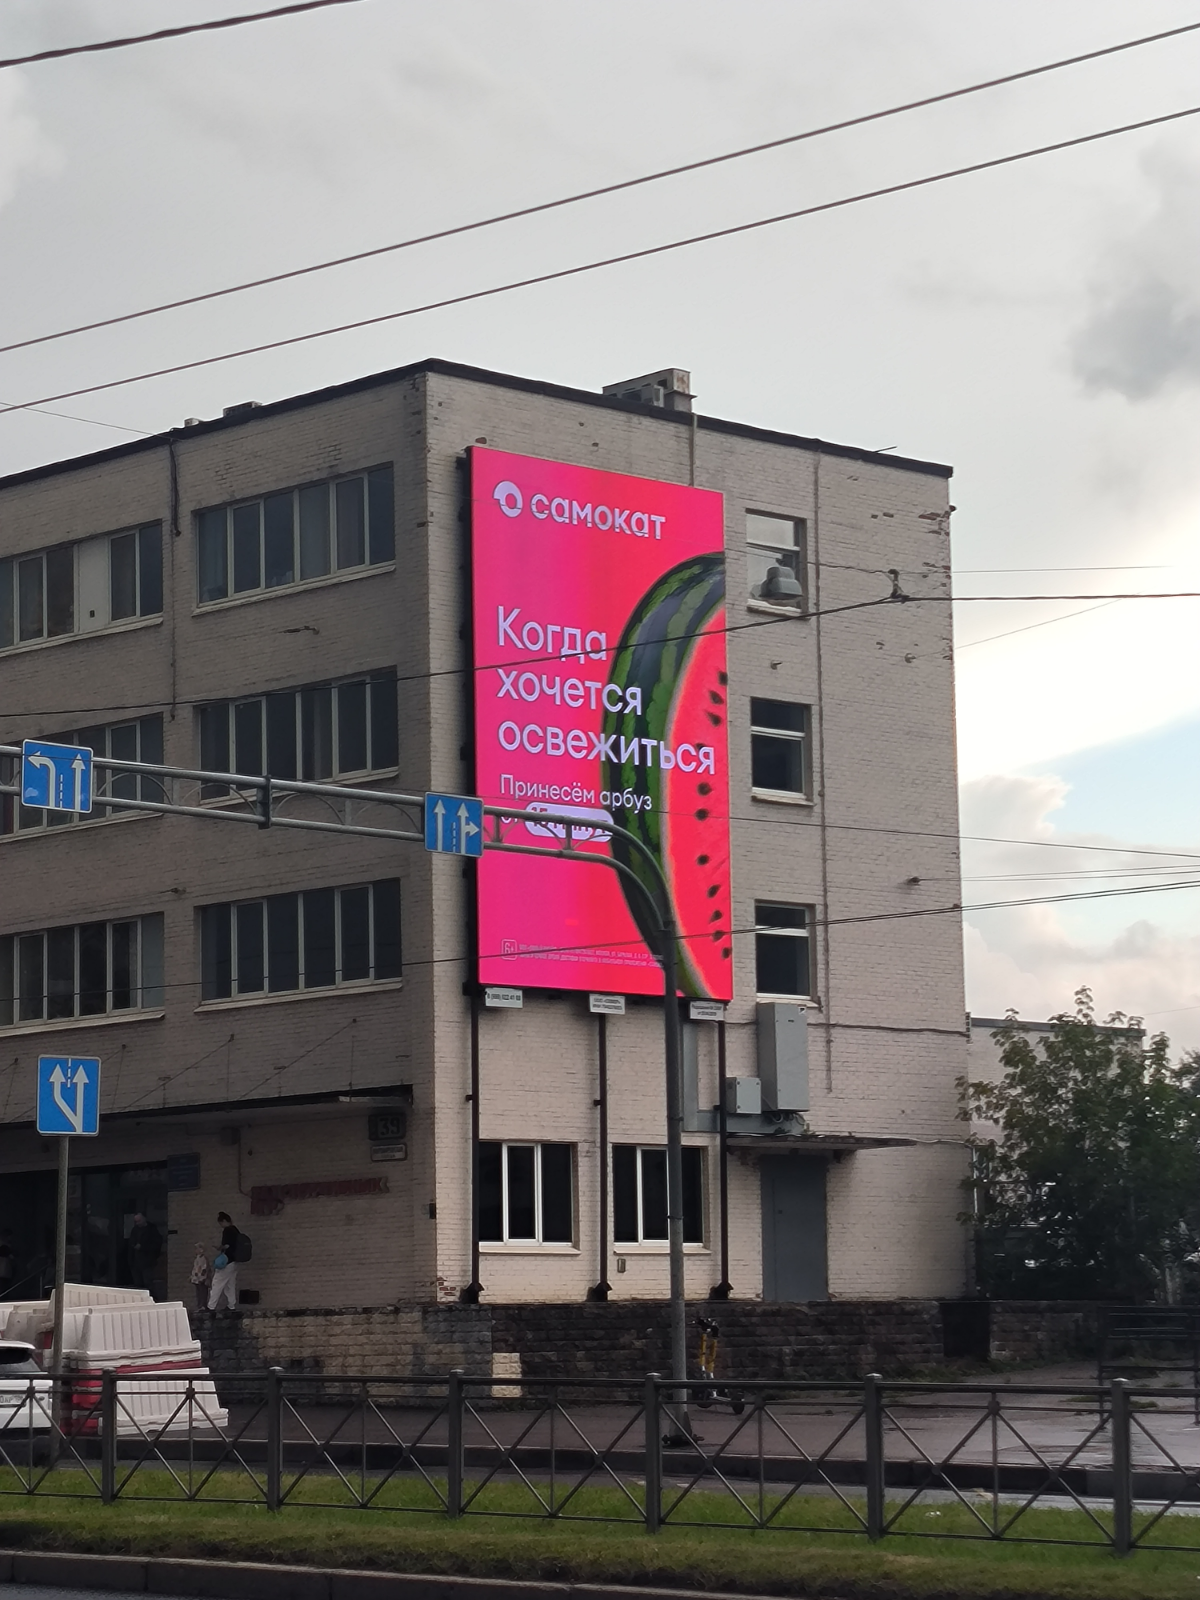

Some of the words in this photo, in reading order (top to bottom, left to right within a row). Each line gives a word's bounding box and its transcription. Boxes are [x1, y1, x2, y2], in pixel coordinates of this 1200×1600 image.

[530, 492, 666, 540] самокат
[496, 604, 608, 665] Когда
[496, 667, 643, 716] хочется
[496, 720, 716, 775] освежиться
[499, 774, 595, 804] Принесём
[599, 787, 653, 811] арбуз
[379, 1116, 401, 1136] 39
